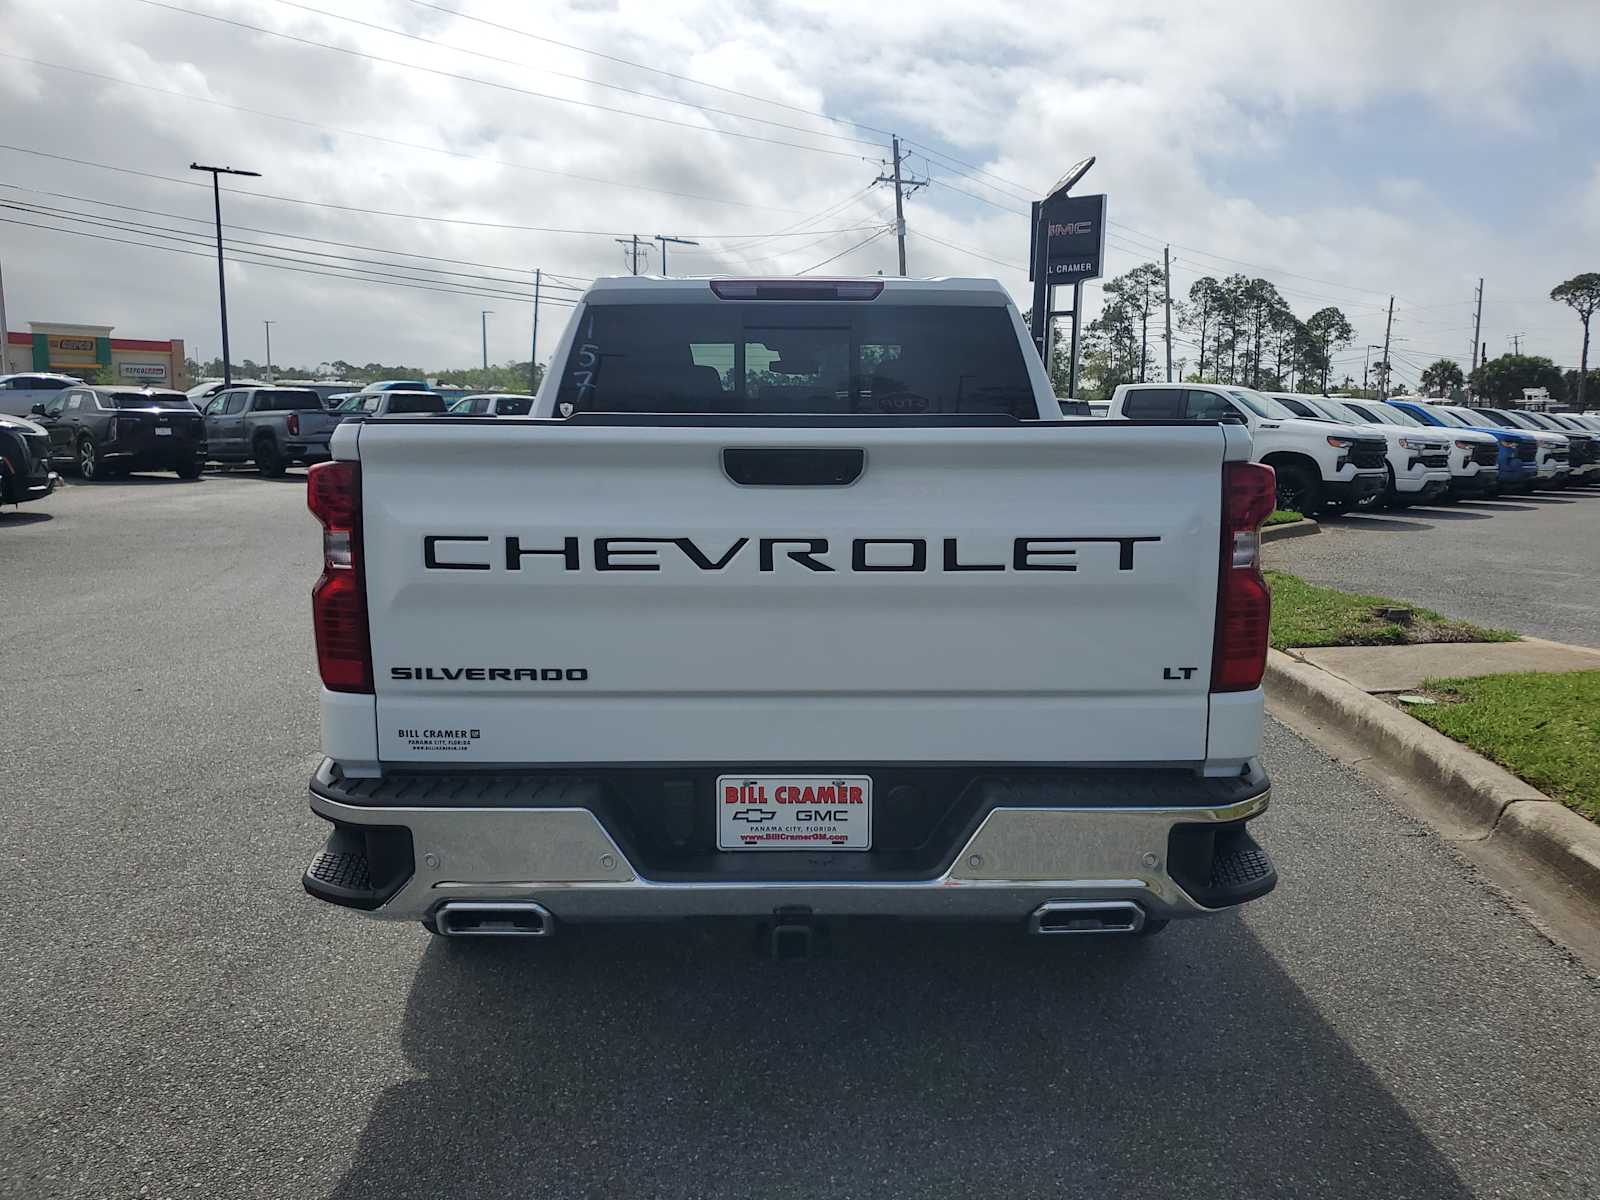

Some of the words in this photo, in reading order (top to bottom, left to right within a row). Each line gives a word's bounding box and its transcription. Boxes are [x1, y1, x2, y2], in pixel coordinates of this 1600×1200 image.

[1056, 263, 1092, 274] CRAMER
[423, 535, 1162, 572] CHEVROLET
[391, 667, 589, 681] SILVERADO
[1163, 667, 1198, 680] LT
[398, 729, 419, 738] BILL
[423, 729, 468, 738] CRAMER
[725, 786, 768, 804] BILL
[774, 786, 864, 805] CRAMER
[796, 810, 849, 822] GMC
